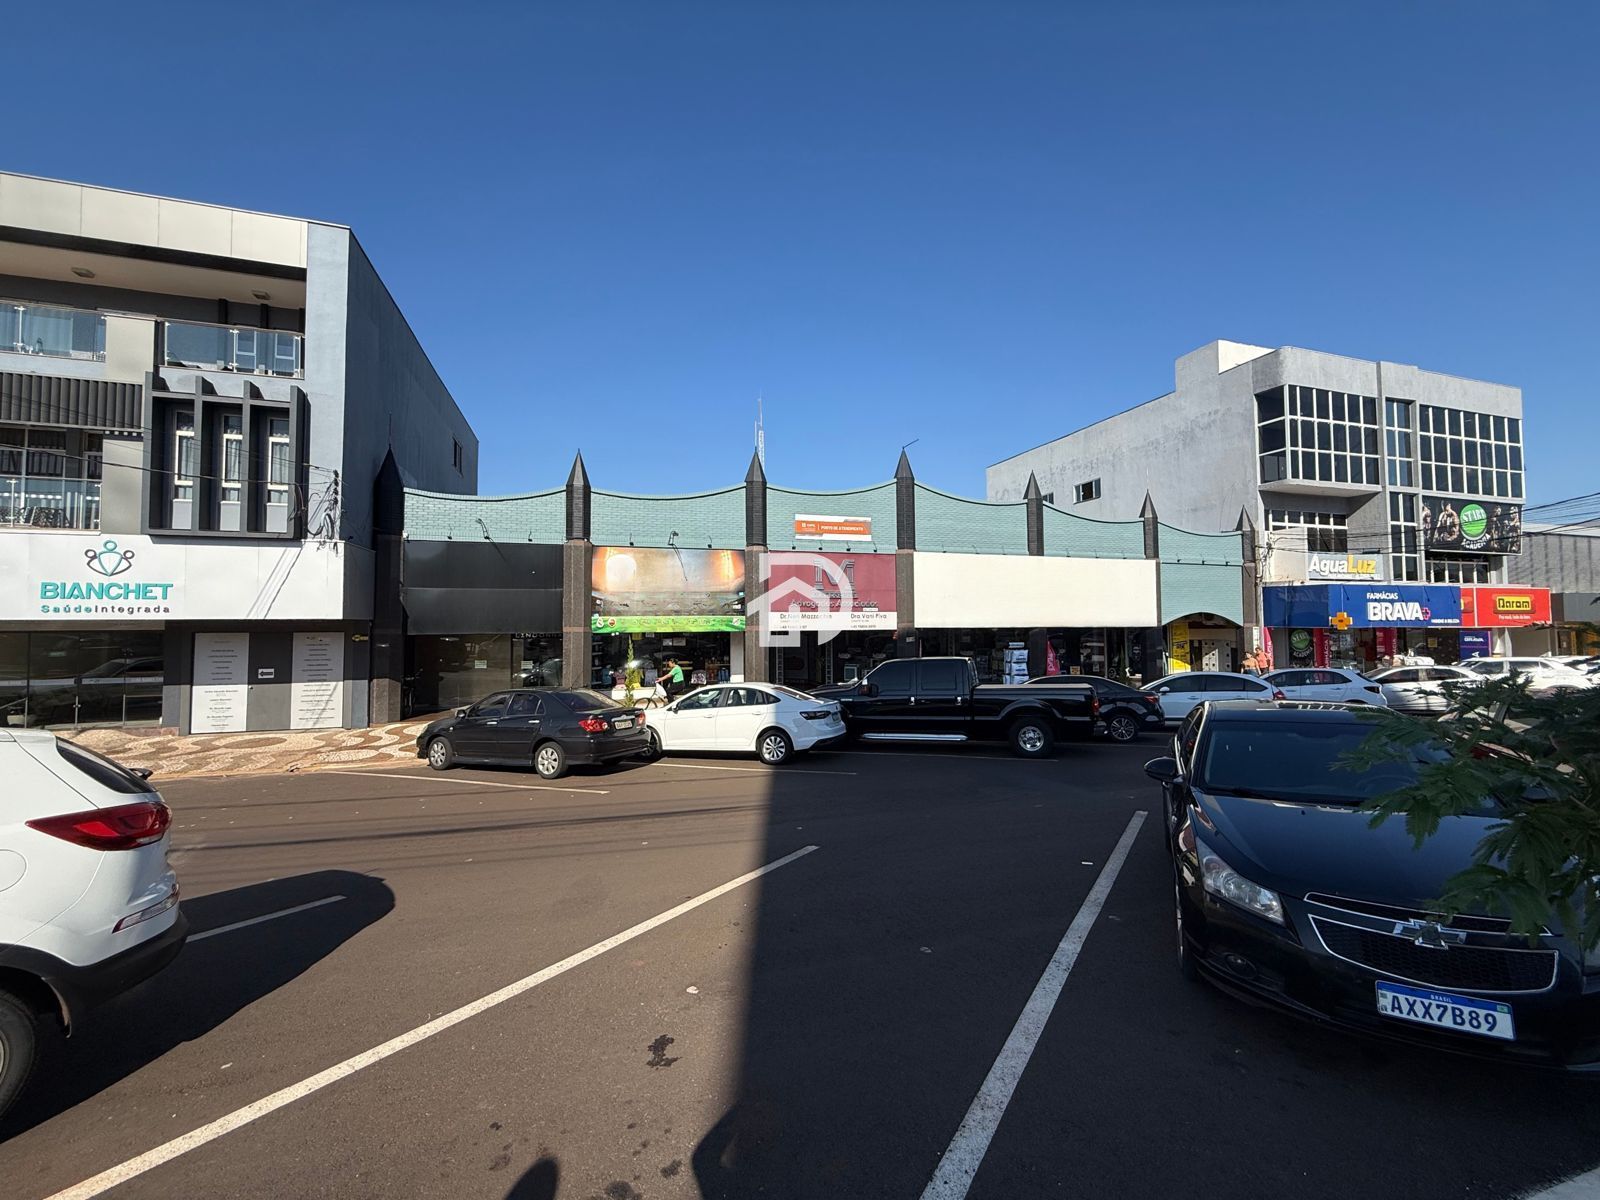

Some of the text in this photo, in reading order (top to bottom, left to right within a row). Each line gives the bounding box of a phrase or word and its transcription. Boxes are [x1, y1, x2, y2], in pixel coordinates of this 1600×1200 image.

[1461, 533, 1491, 550] ACADEMIA
[40, 582, 174, 601] BIANCHET
[1366, 591, 1399, 600] FARMÁCIAS
[1367, 602, 1424, 621] BRAVA
[1390, 995, 1498, 1033] AXX7B89
